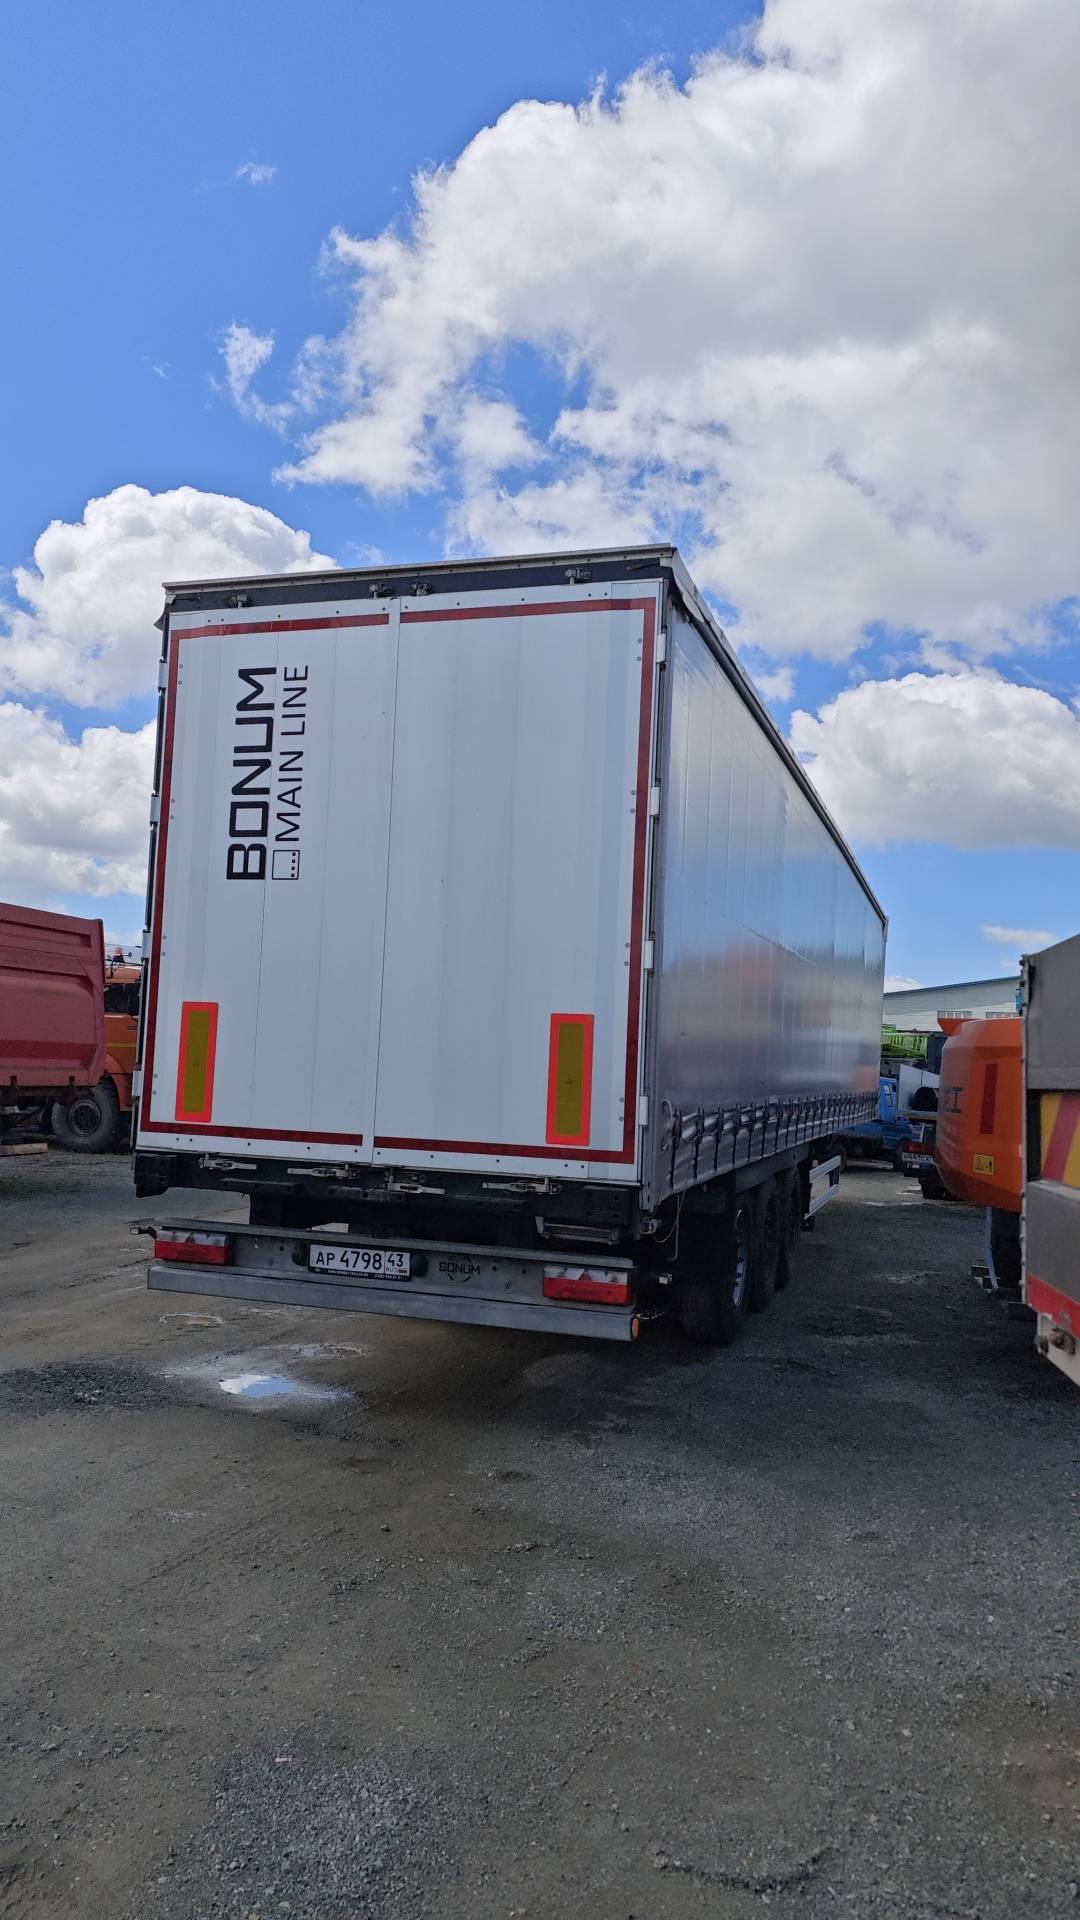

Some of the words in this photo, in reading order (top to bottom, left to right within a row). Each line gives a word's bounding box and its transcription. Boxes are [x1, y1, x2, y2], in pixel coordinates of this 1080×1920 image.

[281, 665, 308, 736] LINE
[226, 667, 277, 880] BONUM
[275, 751, 304, 842] MAIN
[340, 1250, 382, 1270] 4798
[387, 1253, 404, 1267] 43
[439, 1261, 480, 1275] BONUM
